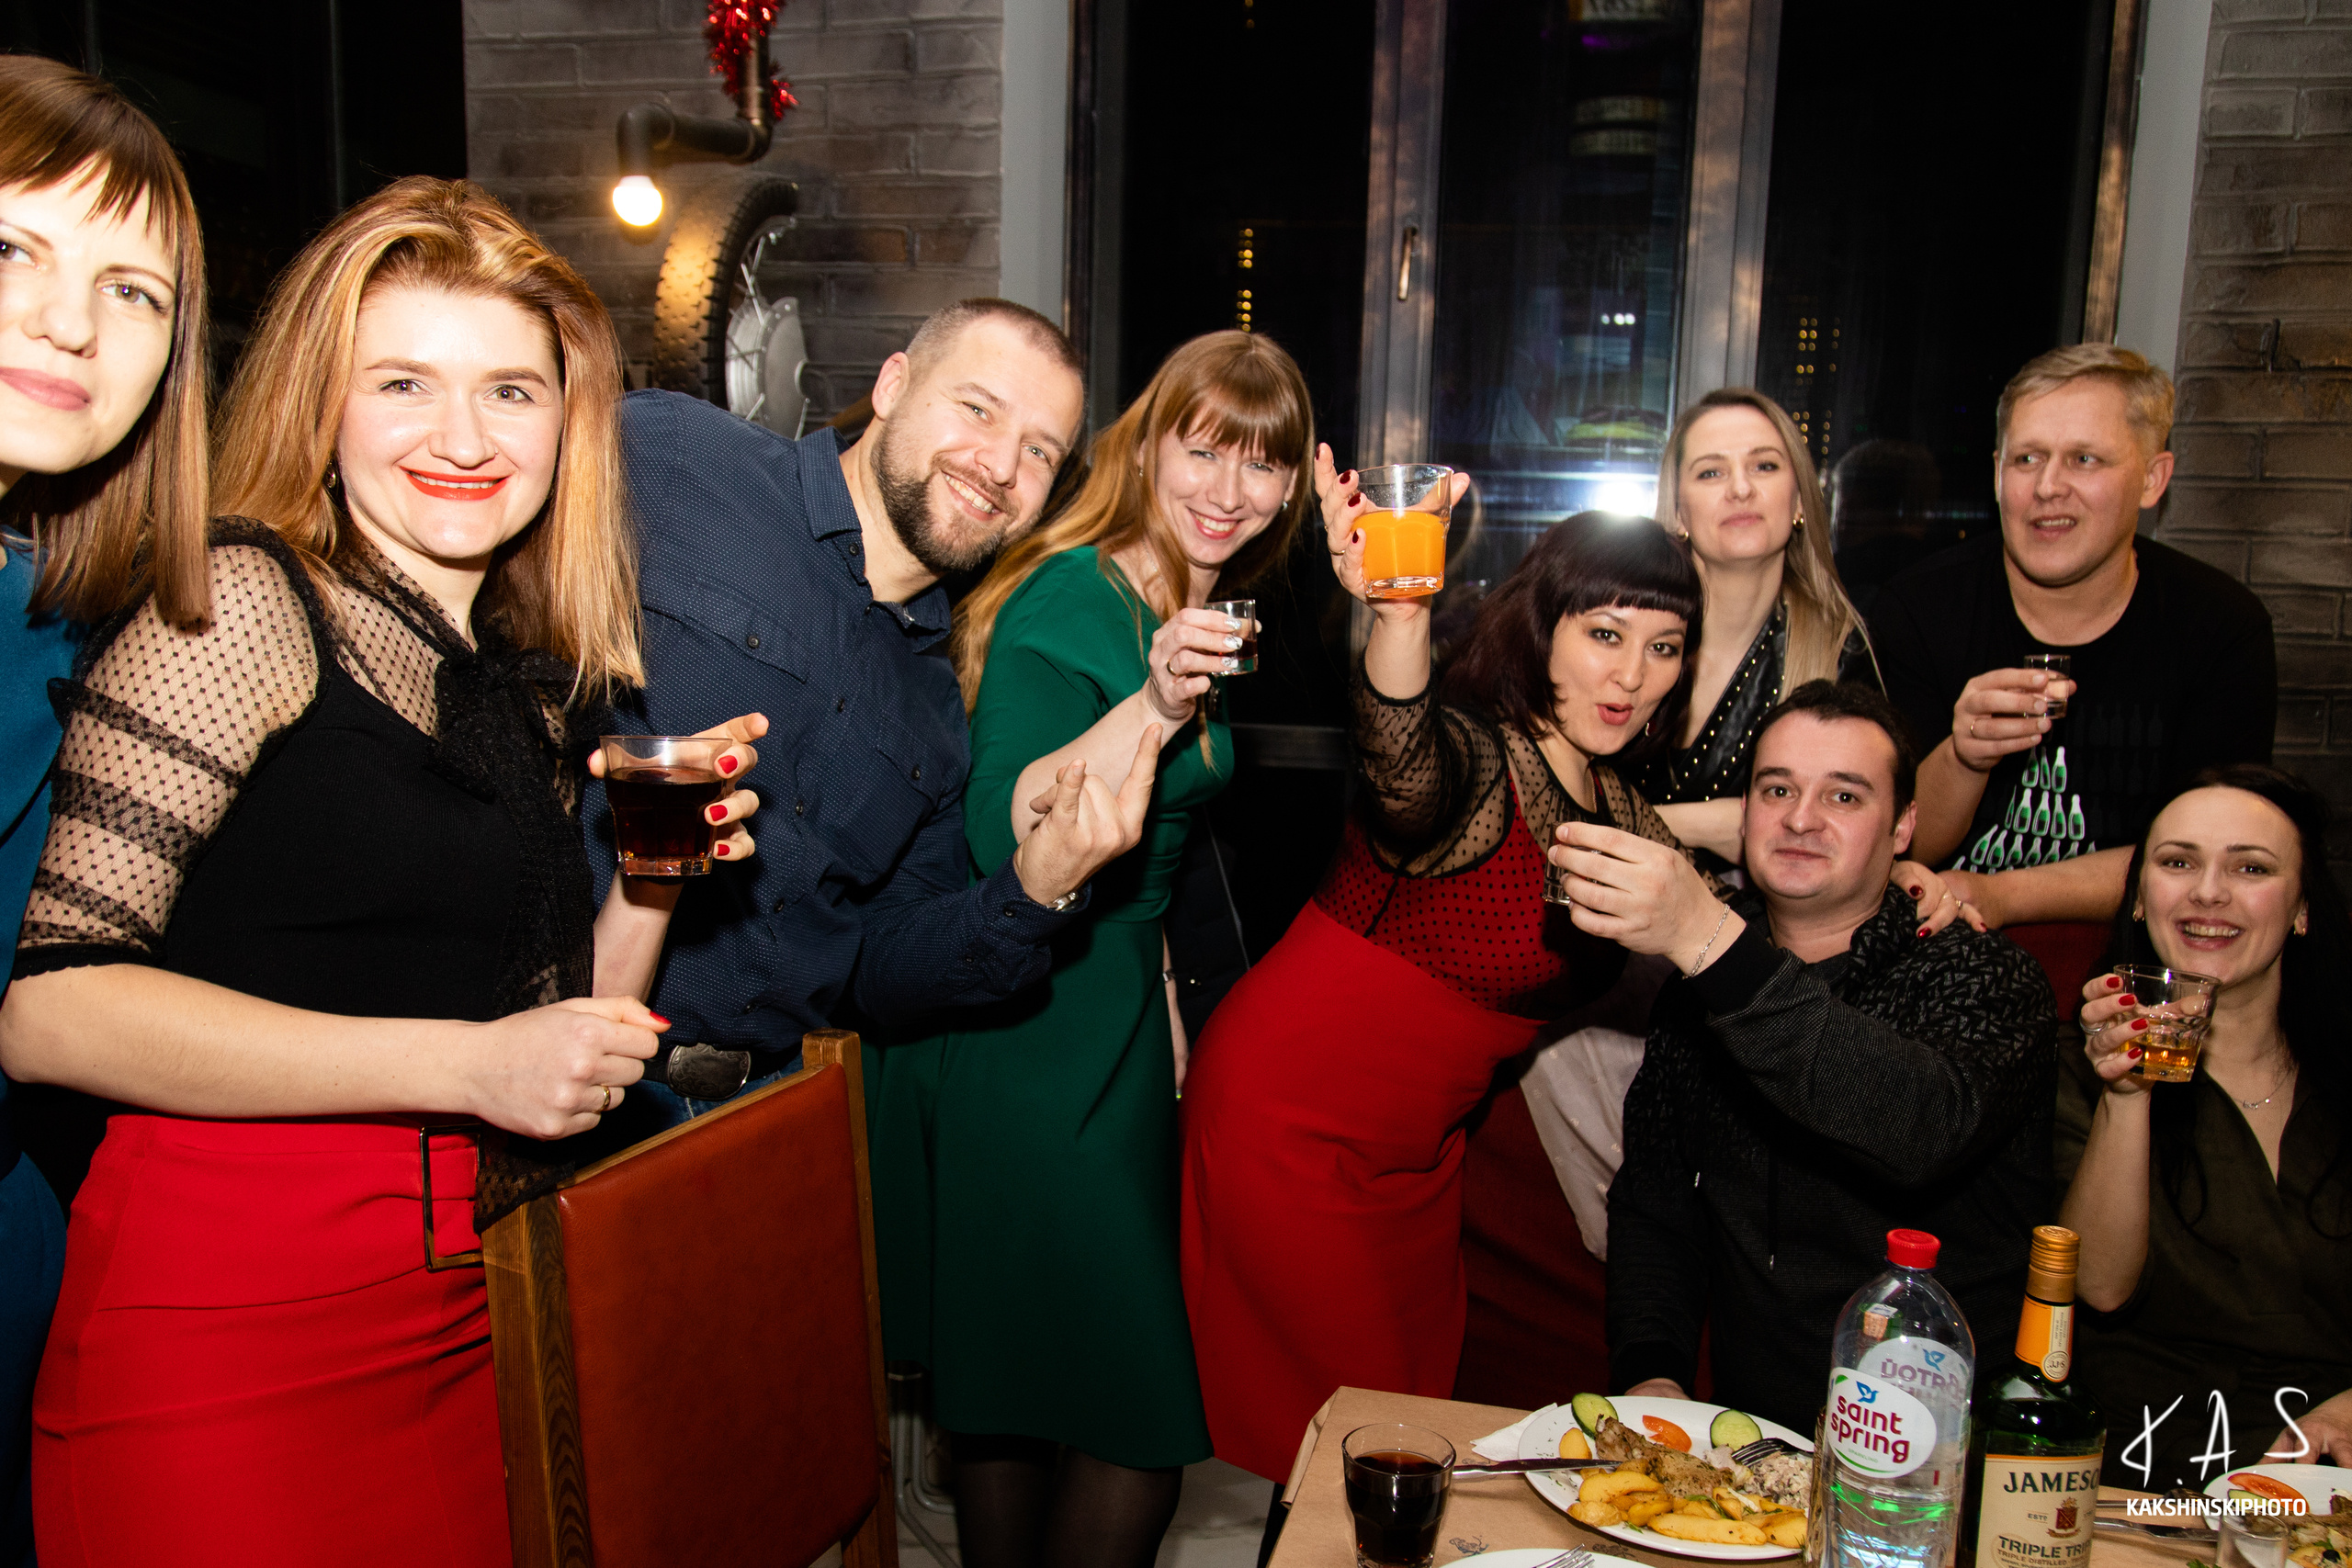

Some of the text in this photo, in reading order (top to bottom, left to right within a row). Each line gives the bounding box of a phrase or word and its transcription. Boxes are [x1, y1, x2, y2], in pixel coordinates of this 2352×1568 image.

[1837, 1395, 1903, 1435] saint
[1830, 1412, 1910, 1463] spring
[1997, 1548, 2026, 1562] TRIPLE
[2029, 1557, 2067, 1566] DISTILLED
[1998, 1535, 2062, 1558] TRIPLE
